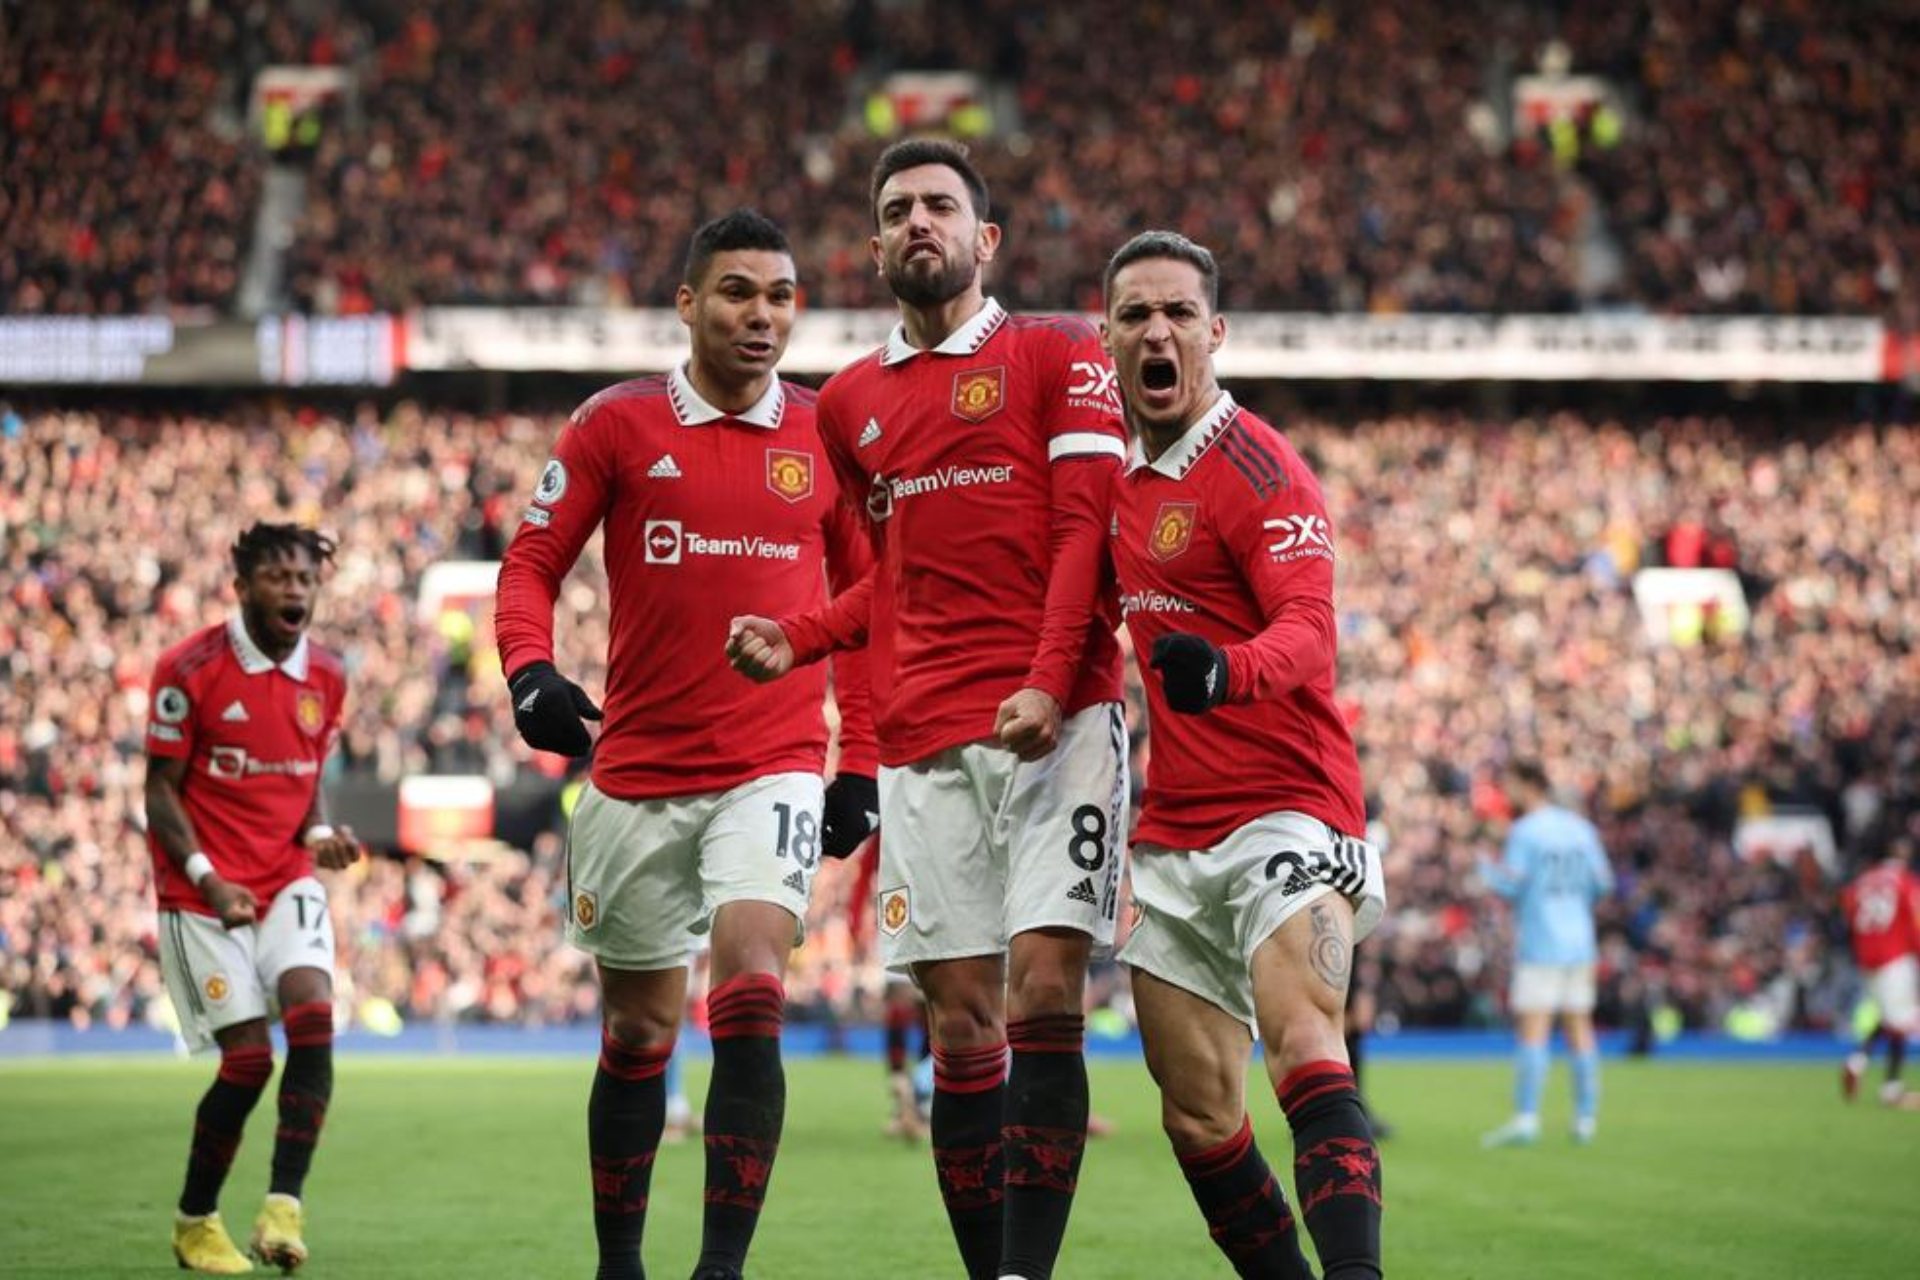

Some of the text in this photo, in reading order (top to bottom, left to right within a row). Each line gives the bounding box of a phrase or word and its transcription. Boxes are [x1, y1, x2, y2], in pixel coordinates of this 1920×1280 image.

[889, 466, 1014, 499] TeamViewer
[684, 532, 800, 560] TeamViewer
[772, 802, 816, 869] 18
[1068, 804, 1106, 871] 8
[292, 893, 328, 931] 17
